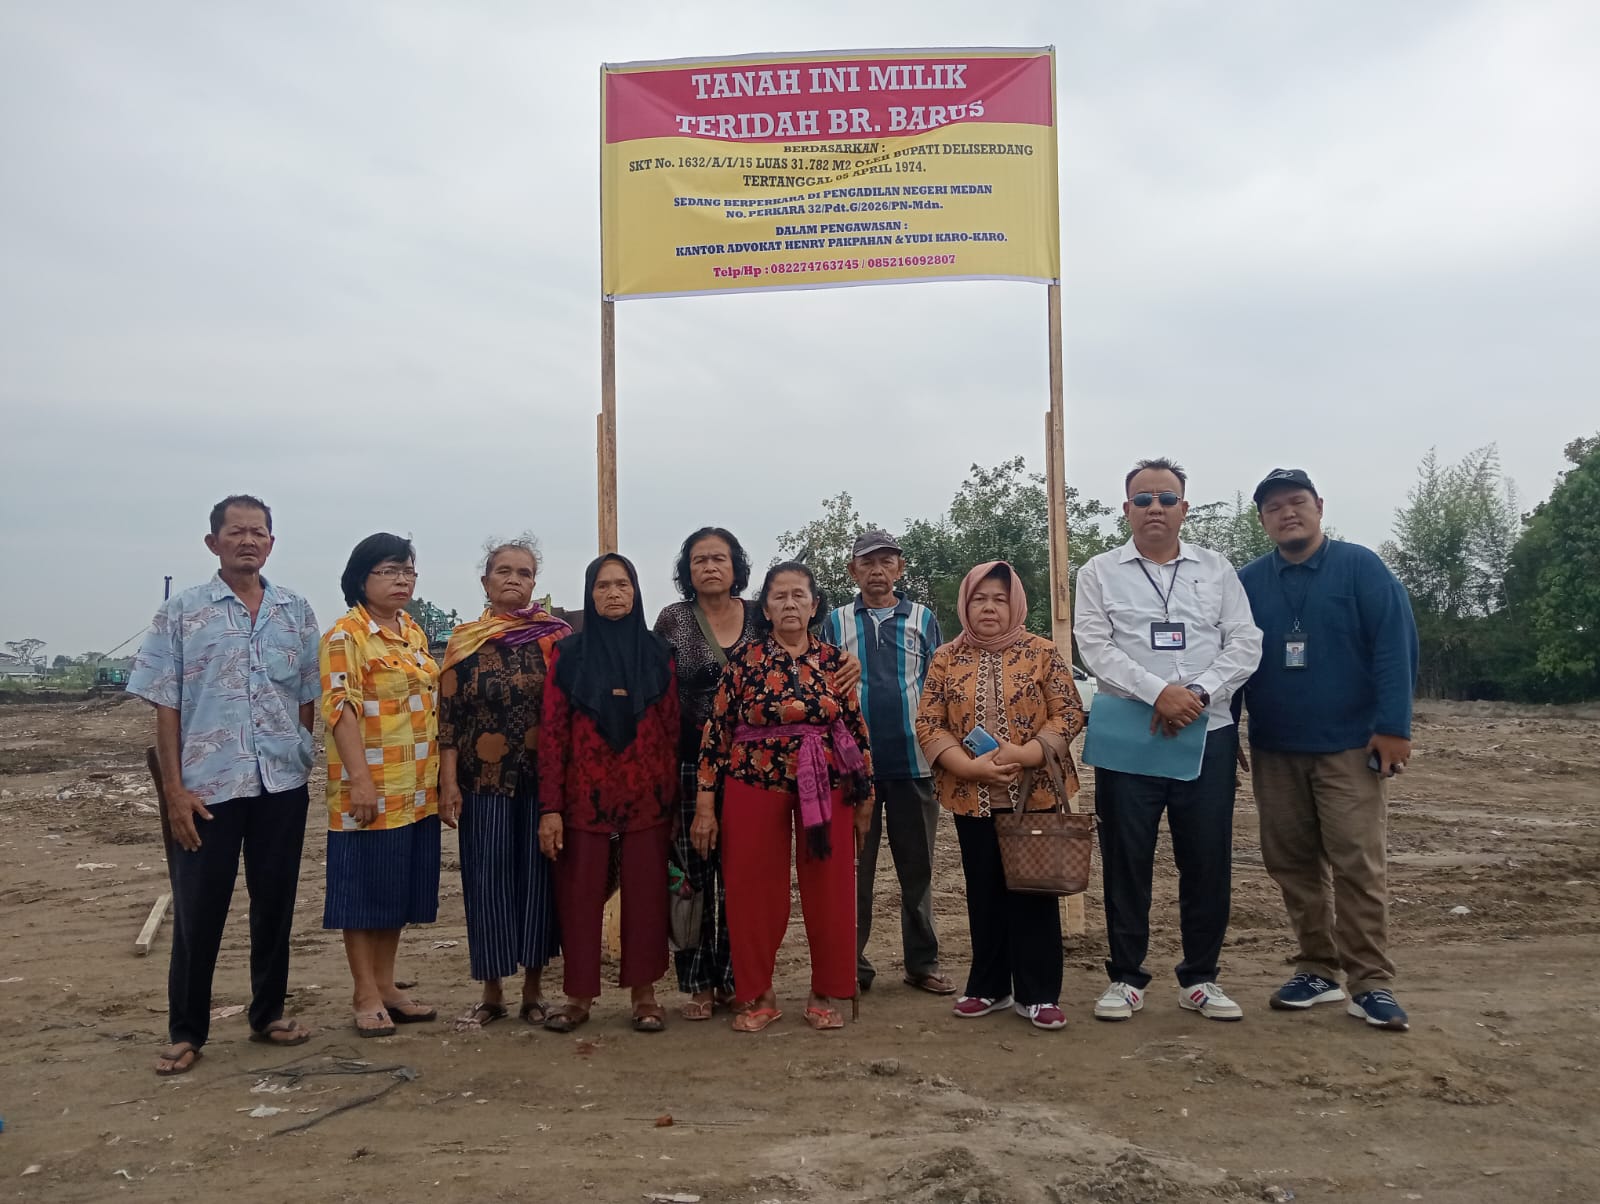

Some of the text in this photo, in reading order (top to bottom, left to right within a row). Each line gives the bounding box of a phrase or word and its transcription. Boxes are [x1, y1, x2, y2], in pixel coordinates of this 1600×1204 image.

[691, 64, 967, 100] TANAH INI MILIK
[675, 100, 985, 139] TERIDAH BR. BARUS
[629, 144, 1033, 172] SKT No. 1632/A/I/15 LUAS 31.782 M2 OLEH BUPATI DELISERDANG
[784, 143, 879, 154] BERDASARKAN
[743, 175, 833, 187] TERTANGGAL
[852, 164, 892, 177] APRIL
[895, 161, 926, 172] 1974.
[674, 185, 992, 207] SEDANG BERPERKARA DI PENGADILAN NEGERI MEDAN
[726, 200, 943, 218] NO. PERKARA 32/Pdt.G/2026/PN-Mdn.
[776, 225, 817, 236] DALAM
[820, 221, 901, 234] PENGAWASAN
[676, 245, 724, 256] KANTOR
[727, 241, 782, 253] ADVOKAT
[785, 239, 825, 250] HENRY
[828, 236, 892, 247] PAKPAHAN
[936, 232, 1007, 243] KARO-KARO.
[713, 265, 761, 278] Telp/Hp
[771, 260, 859, 274] 082274763745
[868, 255, 956, 268] 085216092807
